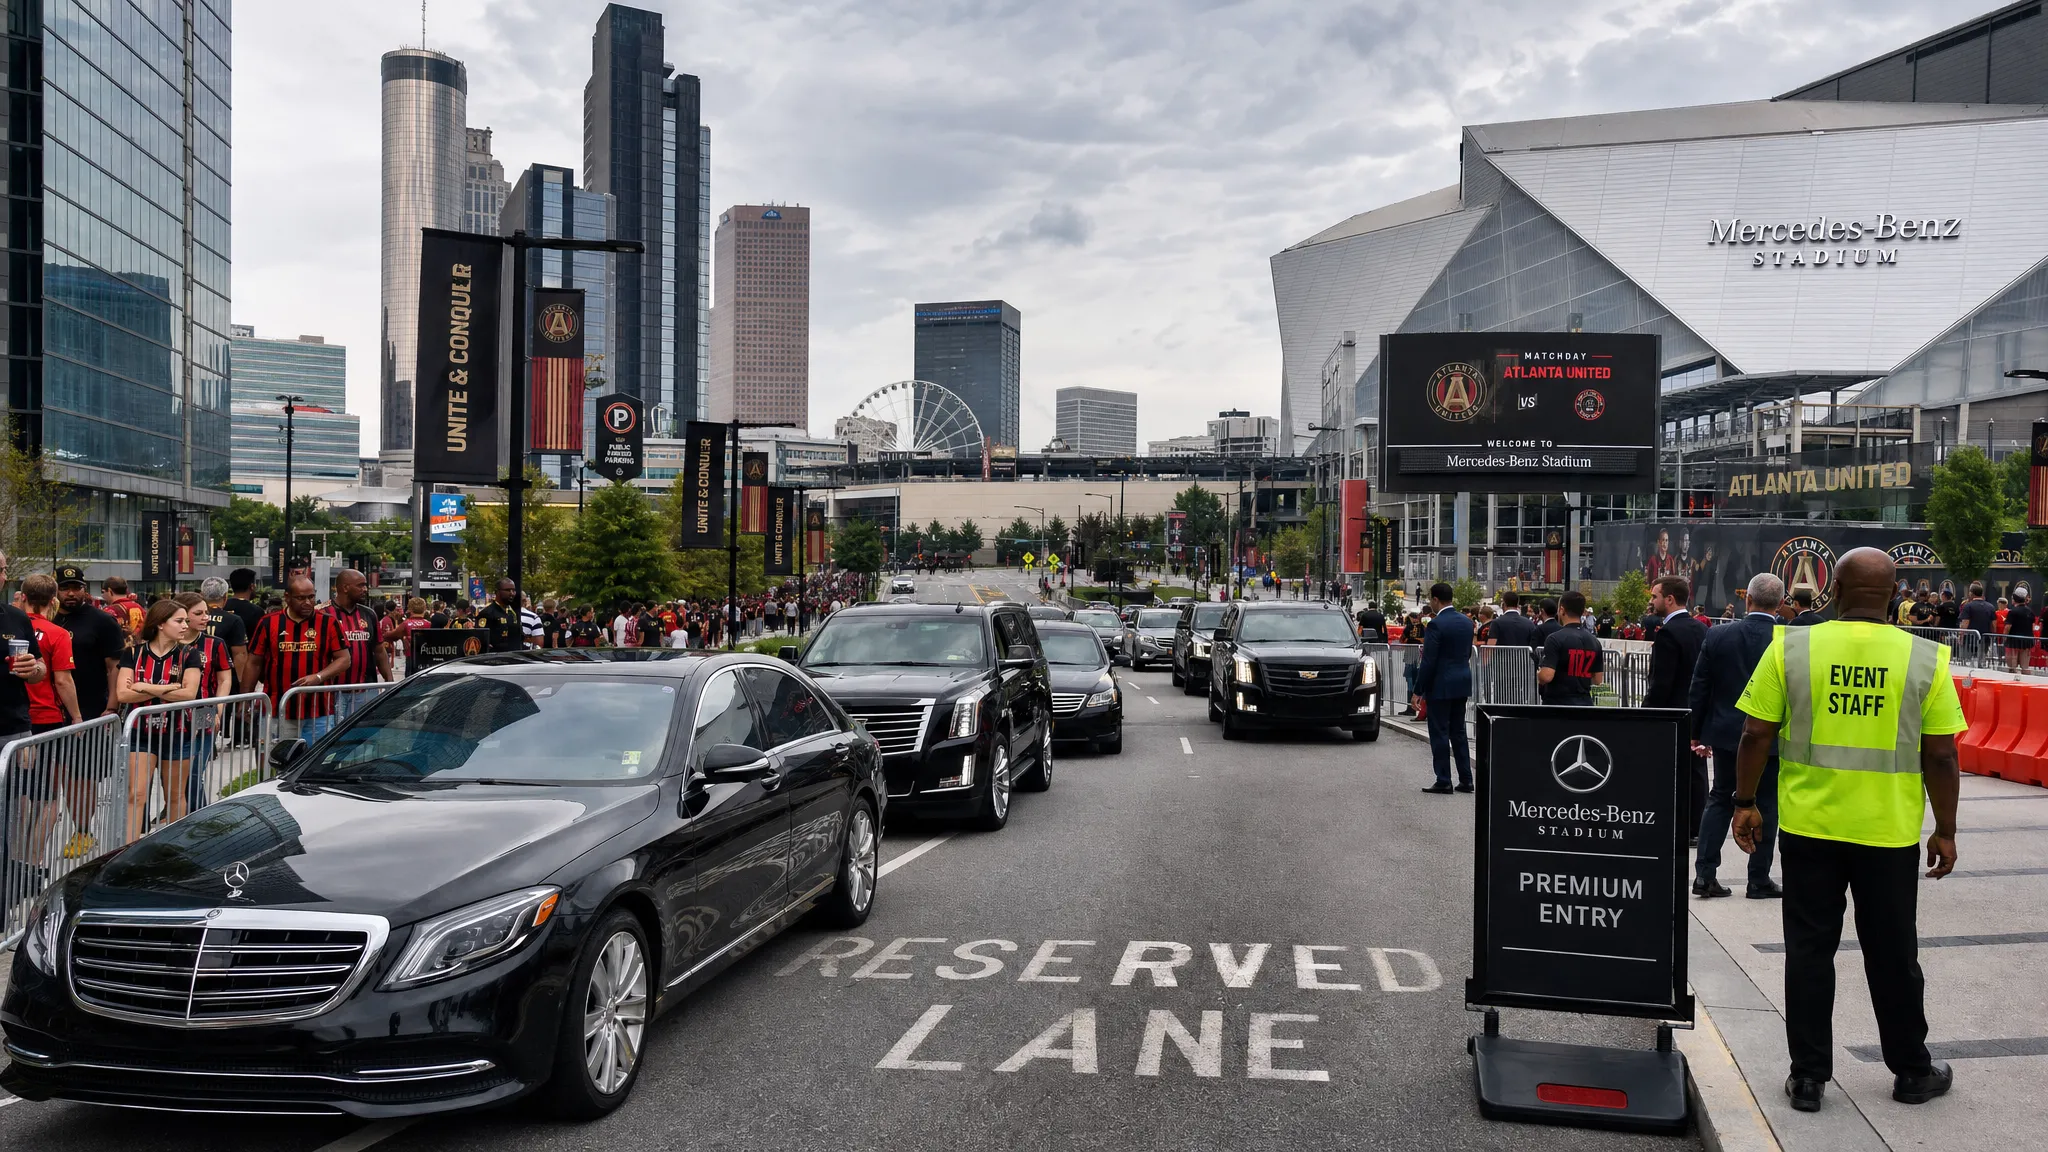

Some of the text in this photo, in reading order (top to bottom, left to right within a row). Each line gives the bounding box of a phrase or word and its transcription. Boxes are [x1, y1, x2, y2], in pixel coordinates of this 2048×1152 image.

[1707, 213, 1963, 244] Mercedes-Benz
[1752, 249, 1898, 267] STADIUM
[447, 263, 472, 452] UNITE & CONQUER
[1524, 352, 1587, 360] MATCHDAY
[1436, 364, 1478, 379] ATLANTA
[1503, 366, 1611, 379] ATLANTA UNITED
[1520, 396, 1536, 408] VS
[613, 408, 628, 427] P
[1486, 440, 1553, 448] WELCOME TO
[1446, 455, 1592, 468] Mercedes-Benz Stadium
[1728, 461, 1912, 498] ATLANTA UNITED
[698, 488, 709, 498] &
[697, 500, 709, 533] UNITE
[1781, 539, 1830, 560] ATLANTA
[1830, 664, 1889, 689] EVENT
[1828, 692, 1885, 717] STAFF
[1507, 800, 1656, 825] Mercedes-Benz
[1537, 825, 1624, 840] STADIUM
[1519, 872, 1643, 900] PREMIUM
[1539, 902, 1624, 929] ENTRY
[773, 937, 1443, 993] RESERVED
[874, 1003, 1330, 1082] LANE
